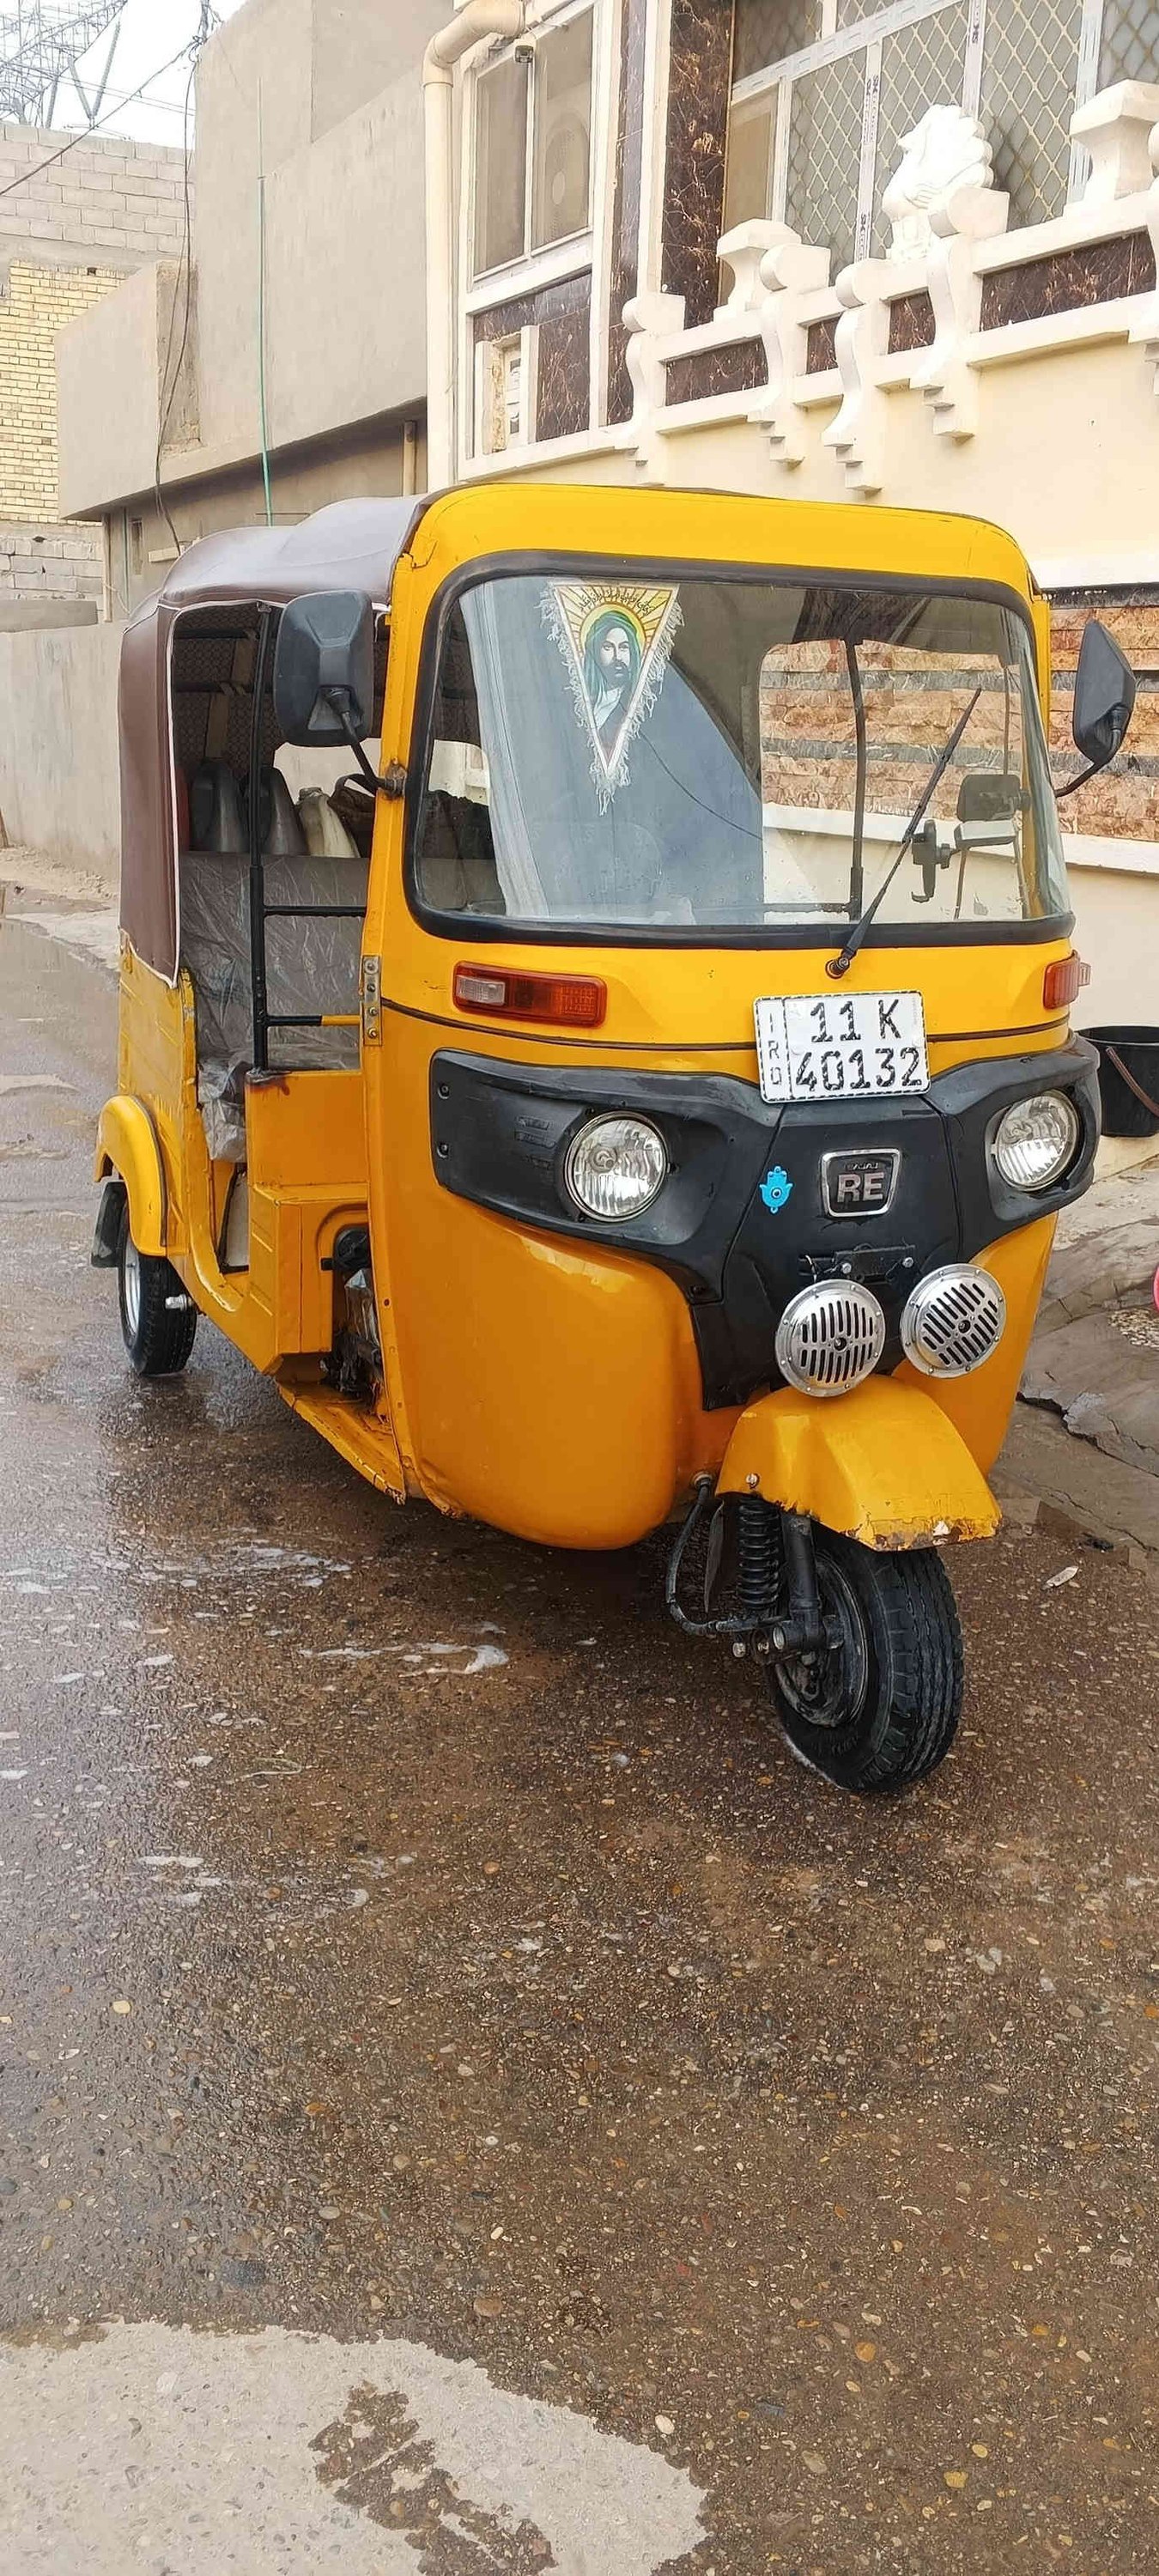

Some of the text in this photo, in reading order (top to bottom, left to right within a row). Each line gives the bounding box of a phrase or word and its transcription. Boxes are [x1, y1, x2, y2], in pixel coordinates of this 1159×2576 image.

[810, 1000, 861, 1042] 11
[877, 999, 901, 1039] K
[795, 1046, 922, 1091] 40132
[836, 1171, 885, 1203] RE
